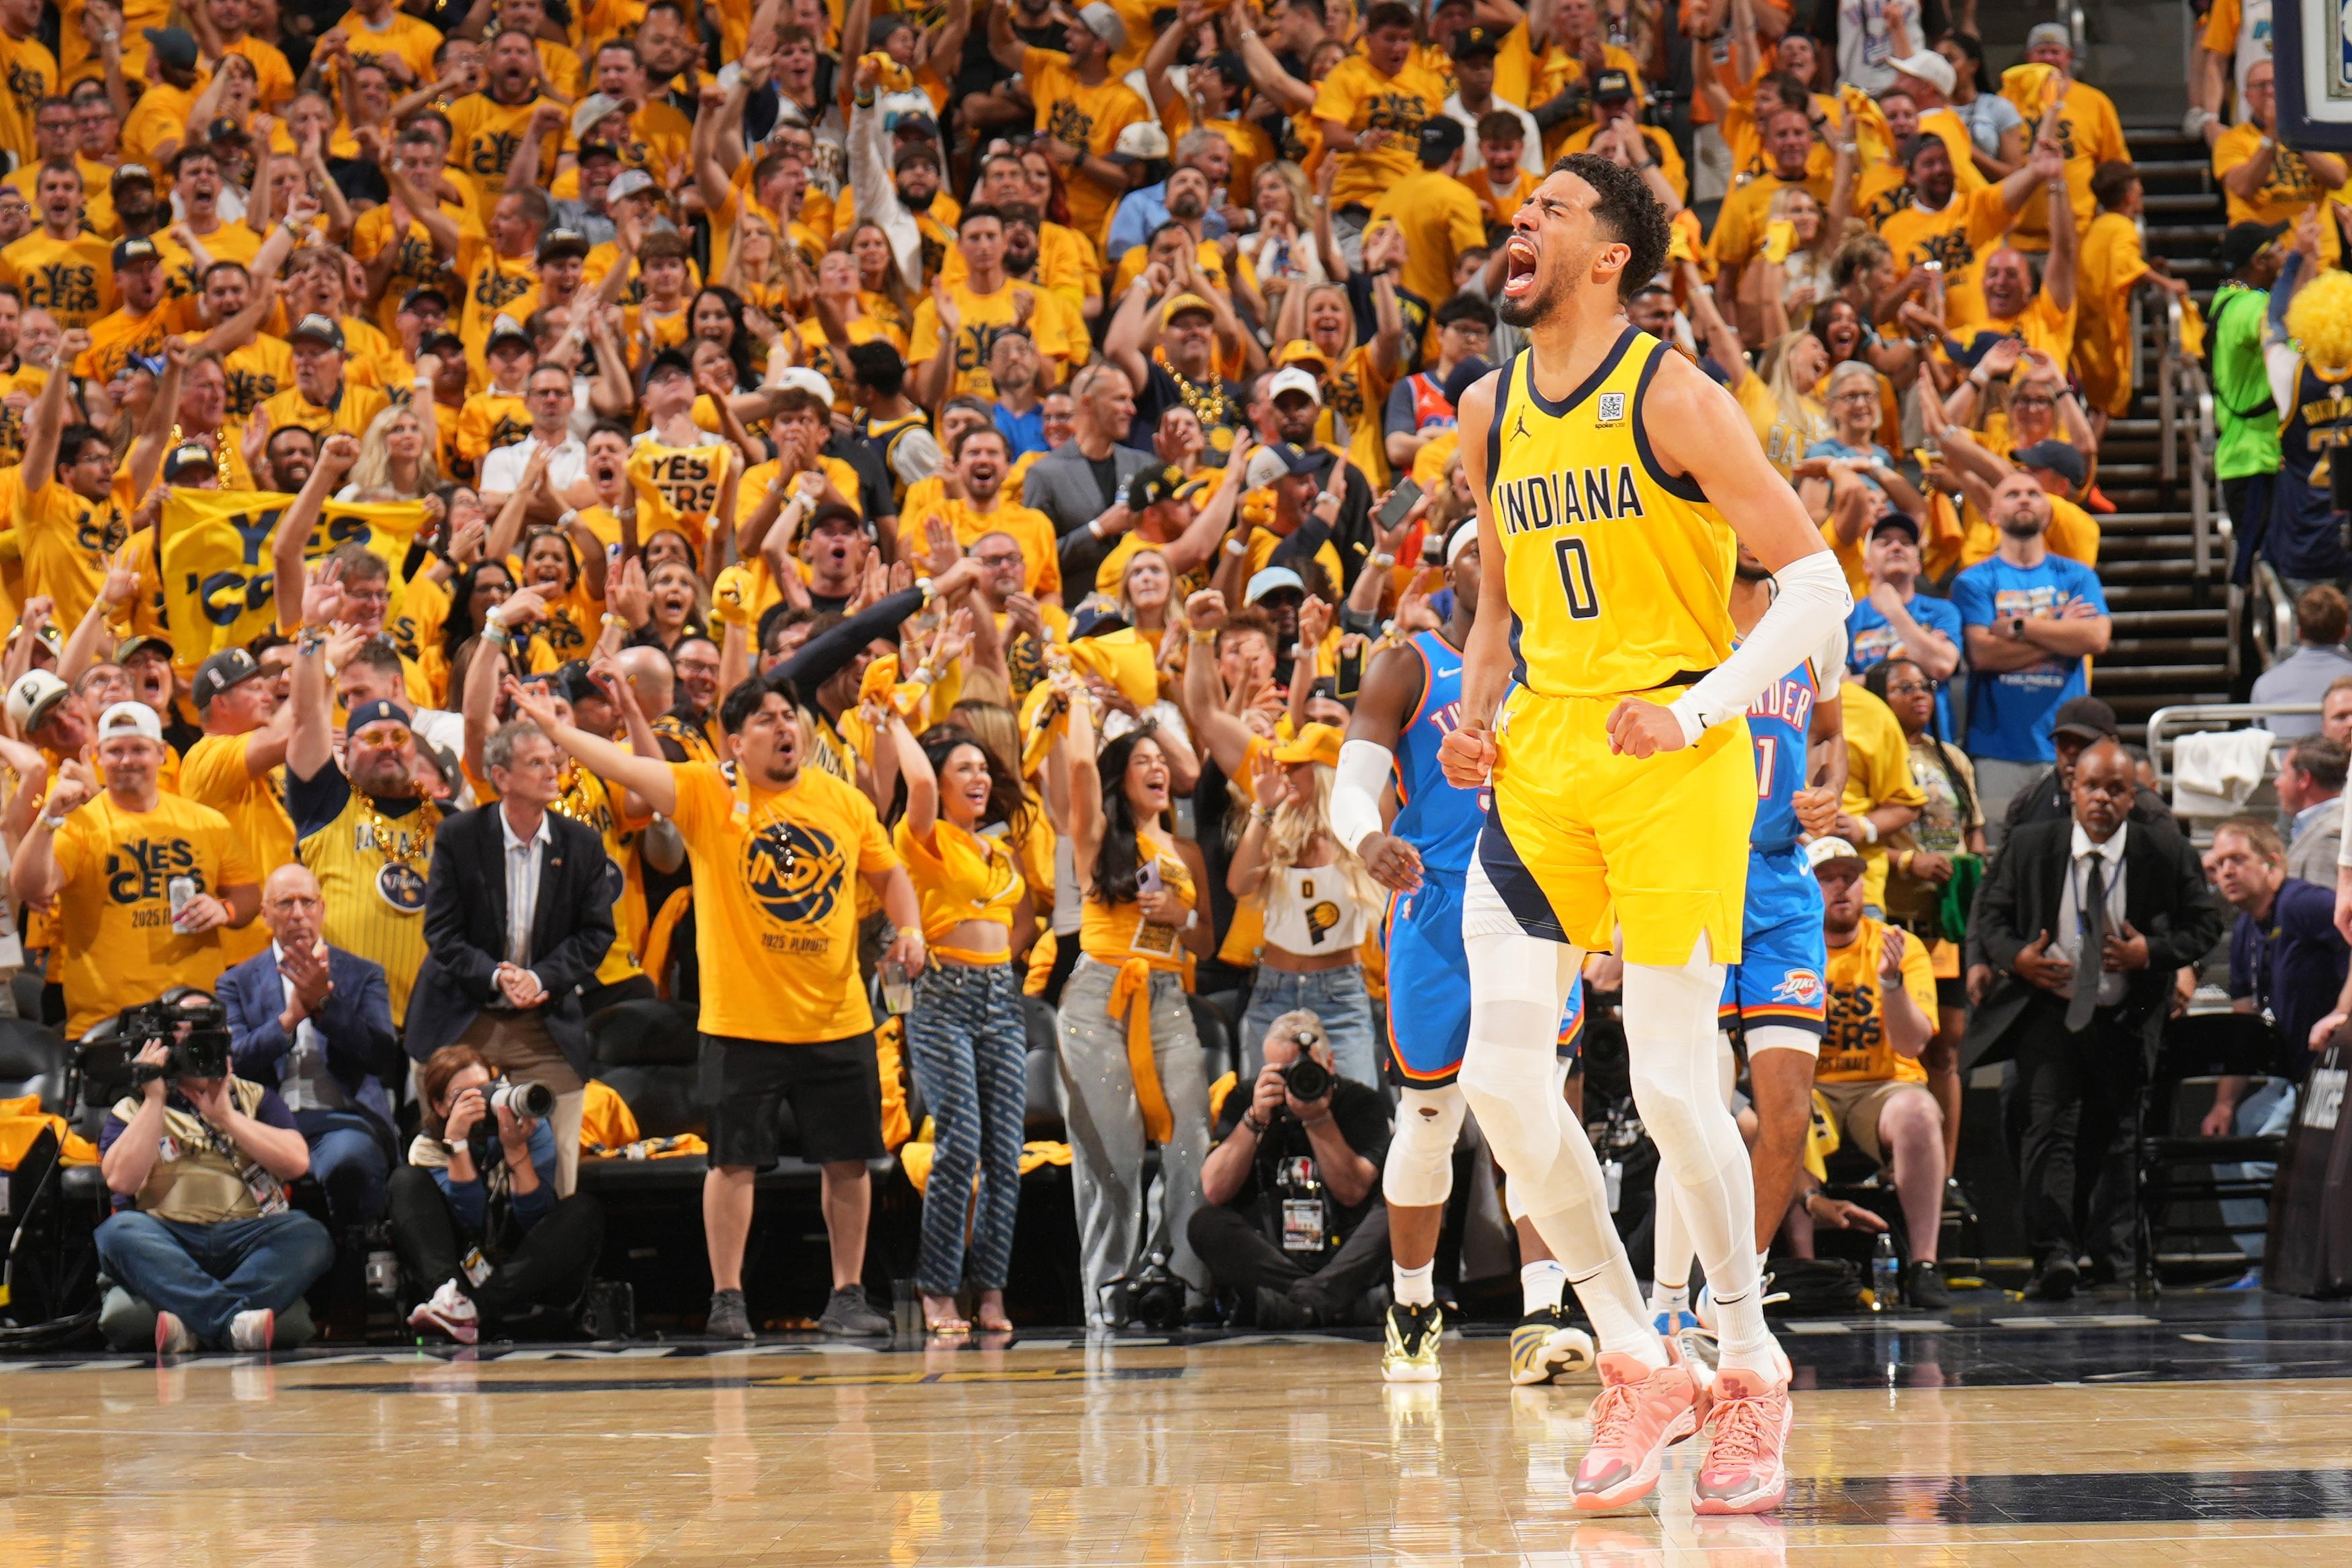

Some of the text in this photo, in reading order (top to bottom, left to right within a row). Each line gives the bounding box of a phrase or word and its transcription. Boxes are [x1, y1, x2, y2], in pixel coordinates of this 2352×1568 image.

[40, 263, 95, 288] YES
[651, 455, 709, 481] YES
[658, 485, 715, 512] ERS
[1498, 465, 1645, 537] INDIANA
[1555, 538, 1600, 620] 0
[1750, 679, 1812, 729] NDER
[122, 839, 194, 869] YES
[748, 850, 843, 894] INDY
[132, 909, 162, 929] 2025
[761, 933, 785, 949] 2025
[1824, 1018, 1880, 1050] ERS
